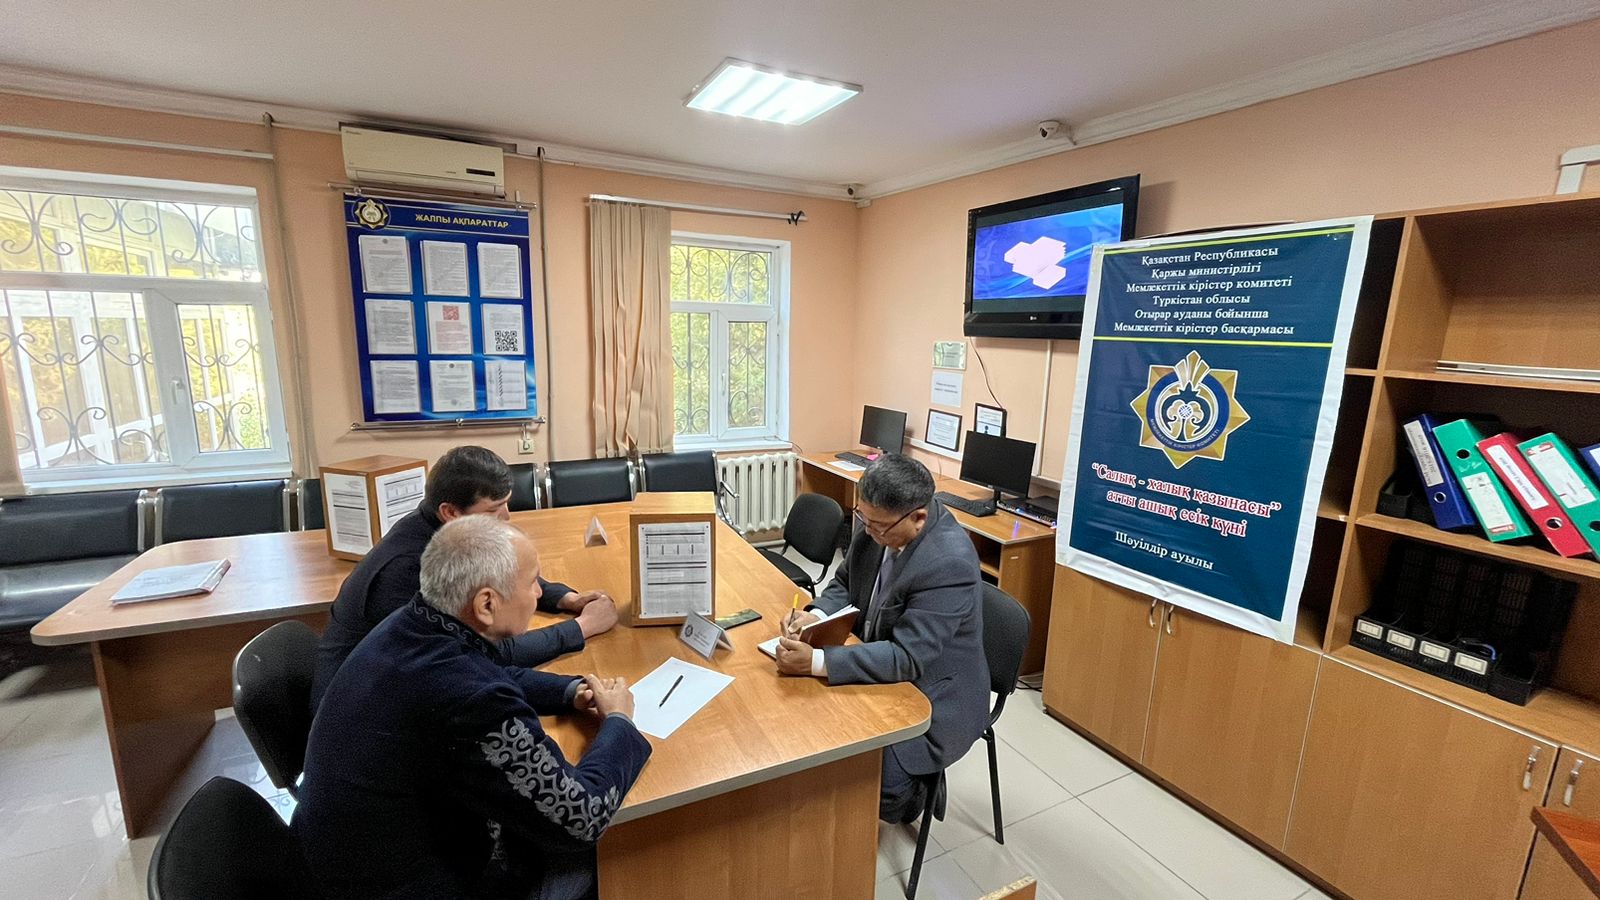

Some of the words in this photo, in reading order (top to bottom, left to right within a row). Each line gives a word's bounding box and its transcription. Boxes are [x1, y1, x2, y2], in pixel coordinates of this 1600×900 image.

[453, 217, 508, 228] АҚПАРАТТАР
[1142, 255, 1190, 266] Қазақстан
[1194, 246, 1279, 262] Республикасы
[1152, 268, 1187, 279] Қаржы
[1189, 262, 1261, 276] министірлігі
[1126, 282, 1187, 293] Мемлекеттік
[1189, 282, 1233, 293] кірістер
[1236, 276, 1292, 288] комитеті
[1153, 295, 1203, 306] Түркістан
[1206, 294, 1250, 304] облысы
[1135, 310, 1171, 320] Отырар
[1174, 310, 1212, 319] ауданы
[1215, 308, 1268, 318] бойынша
[1114, 322, 1173, 332] Мемлекеттік
[1176, 324, 1218, 334] кірістер
[1221, 324, 1294, 336] басқармасы
[1092, 462, 1135, 486] “Салық
[1147, 479, 1190, 497] халық
[1193, 490, 1281, 518] қазынасы”
[1107, 490, 1137, 508] атты
[1138, 499, 1177, 520] ашық
[1180, 508, 1209, 525] есік
[1211, 518, 1248, 538] күні
[1115, 531, 1168, 558] Шәуілдір
[1170, 550, 1214, 570] ауылы
